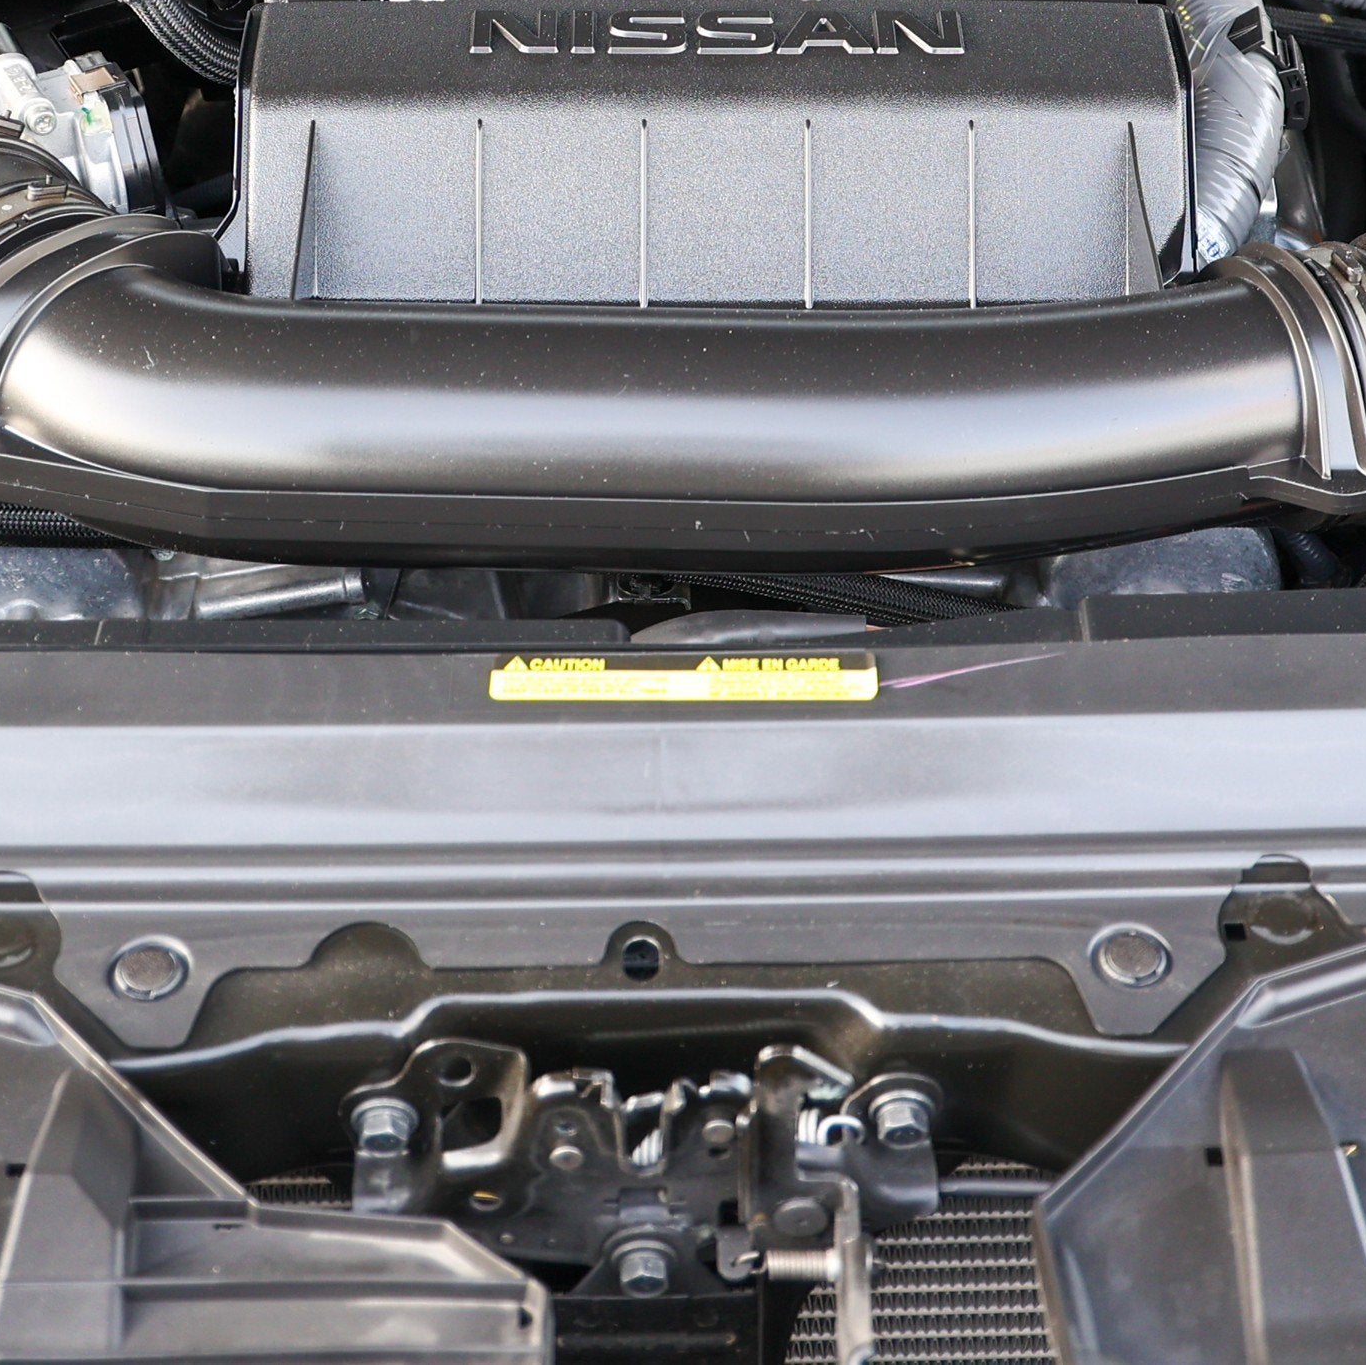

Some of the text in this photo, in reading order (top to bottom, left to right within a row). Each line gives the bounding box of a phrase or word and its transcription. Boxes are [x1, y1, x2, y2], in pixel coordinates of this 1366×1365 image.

[467, 8, 967, 56] NISSAN
[529, 657, 606, 671] CAUTION
[722, 657, 841, 671] MISE EN GARDE
